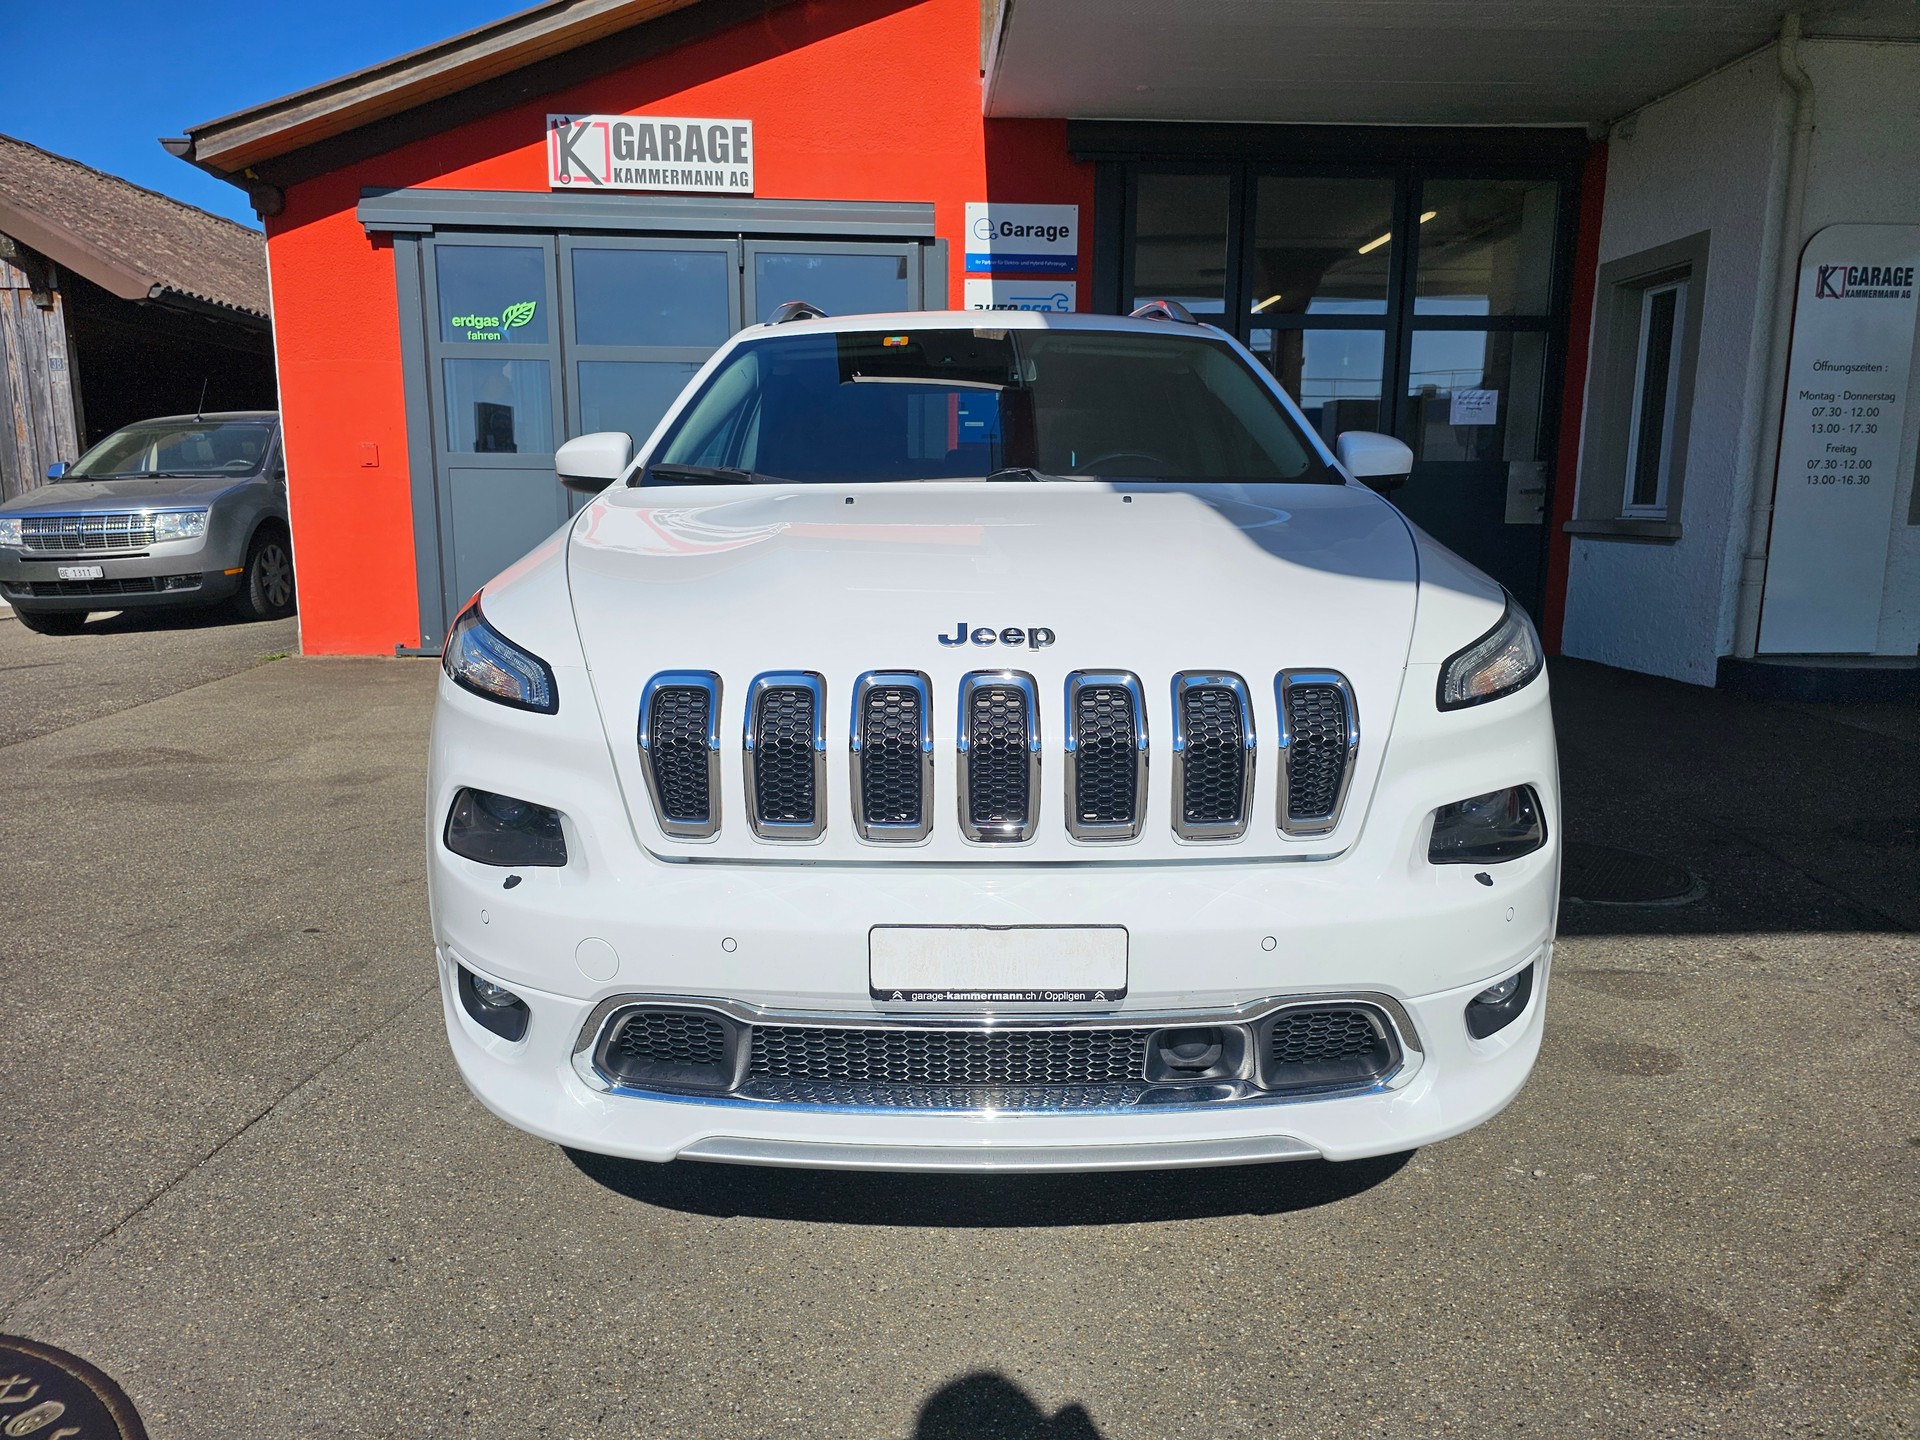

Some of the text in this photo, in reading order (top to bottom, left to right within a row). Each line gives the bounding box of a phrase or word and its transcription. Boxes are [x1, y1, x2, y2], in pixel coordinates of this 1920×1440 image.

[612, 122, 749, 164] GARAGE
[613, 168, 749, 187] KAMMERMANN AG
[1000, 221, 1070, 242] Garage
[1847, 266, 1914, 287] GARAGE
[1845, 290, 1911, 299] KAMMERMANN AG
[451, 314, 500, 329] erdgas
[467, 331, 501, 340] fahren
[1813, 359, 1883, 374] Öffnungszeiten
[1800, 391, 1835, 403] Montag
[1843, 391, 1896, 403] Donnerstag
[1812, 407, 1842, 417] 07.30
[1851, 408, 1880, 417] 12.00
[1812, 424, 1840, 434] 13.00
[1849, 424, 1878, 434] 17.30
[1826, 443, 1857, 456] Freitag
[1807, 460, 1838, 469] 07.30
[1807, 475, 1836, 485] 13.00
[938, 622, 1056, 653] Jeep
[911, 991, 1037, 1001] garage-kammermann.ch
[1044, 991, 1086, 1002] Oppligen
